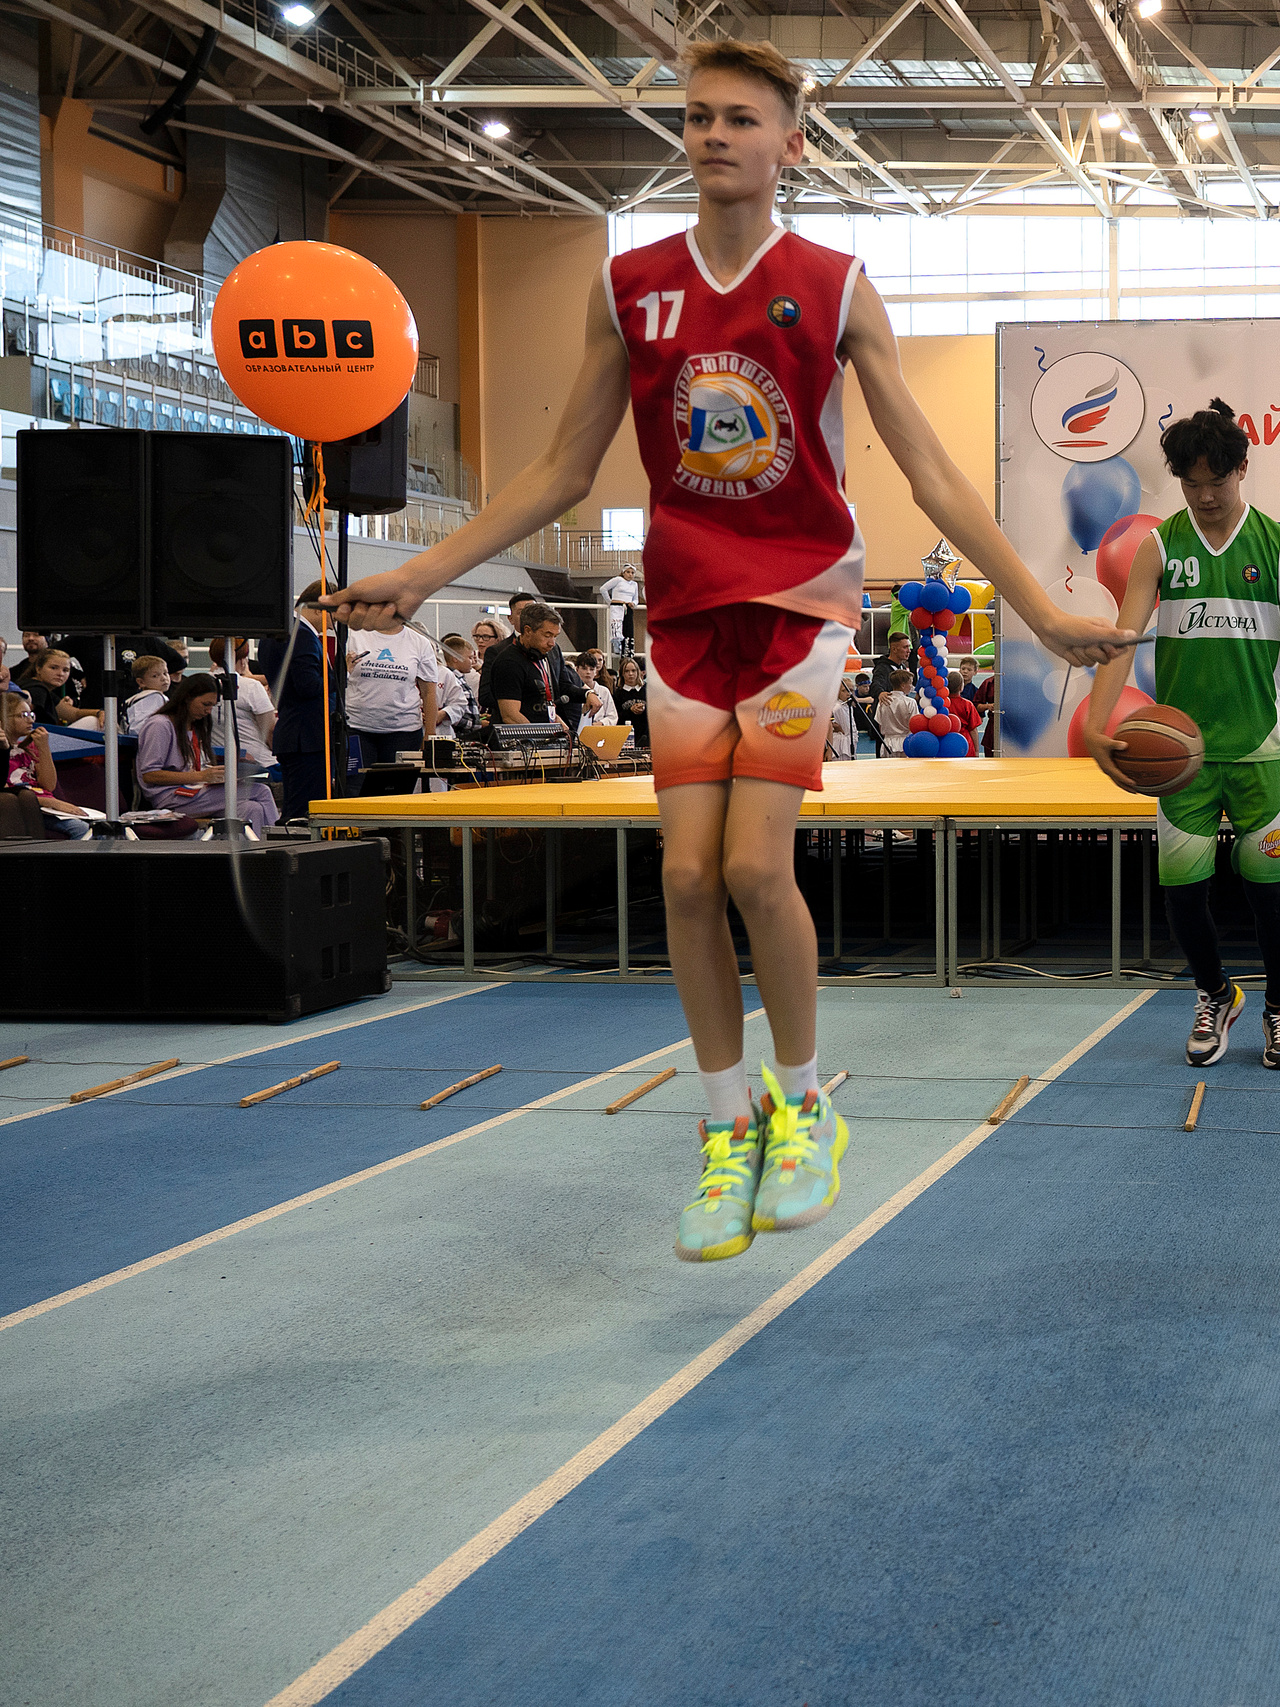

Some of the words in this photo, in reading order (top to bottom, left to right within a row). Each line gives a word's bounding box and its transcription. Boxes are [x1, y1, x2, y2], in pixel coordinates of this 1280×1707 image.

[636, 289, 685, 342] 17
[247, 323, 364, 350] abc
[245, 363, 342, 373] ОБРАЗОВАТЕЛЬНЫЙ
[347, 364, 375, 373] ЦЕНТР
[1167, 556, 1200, 589] 29
